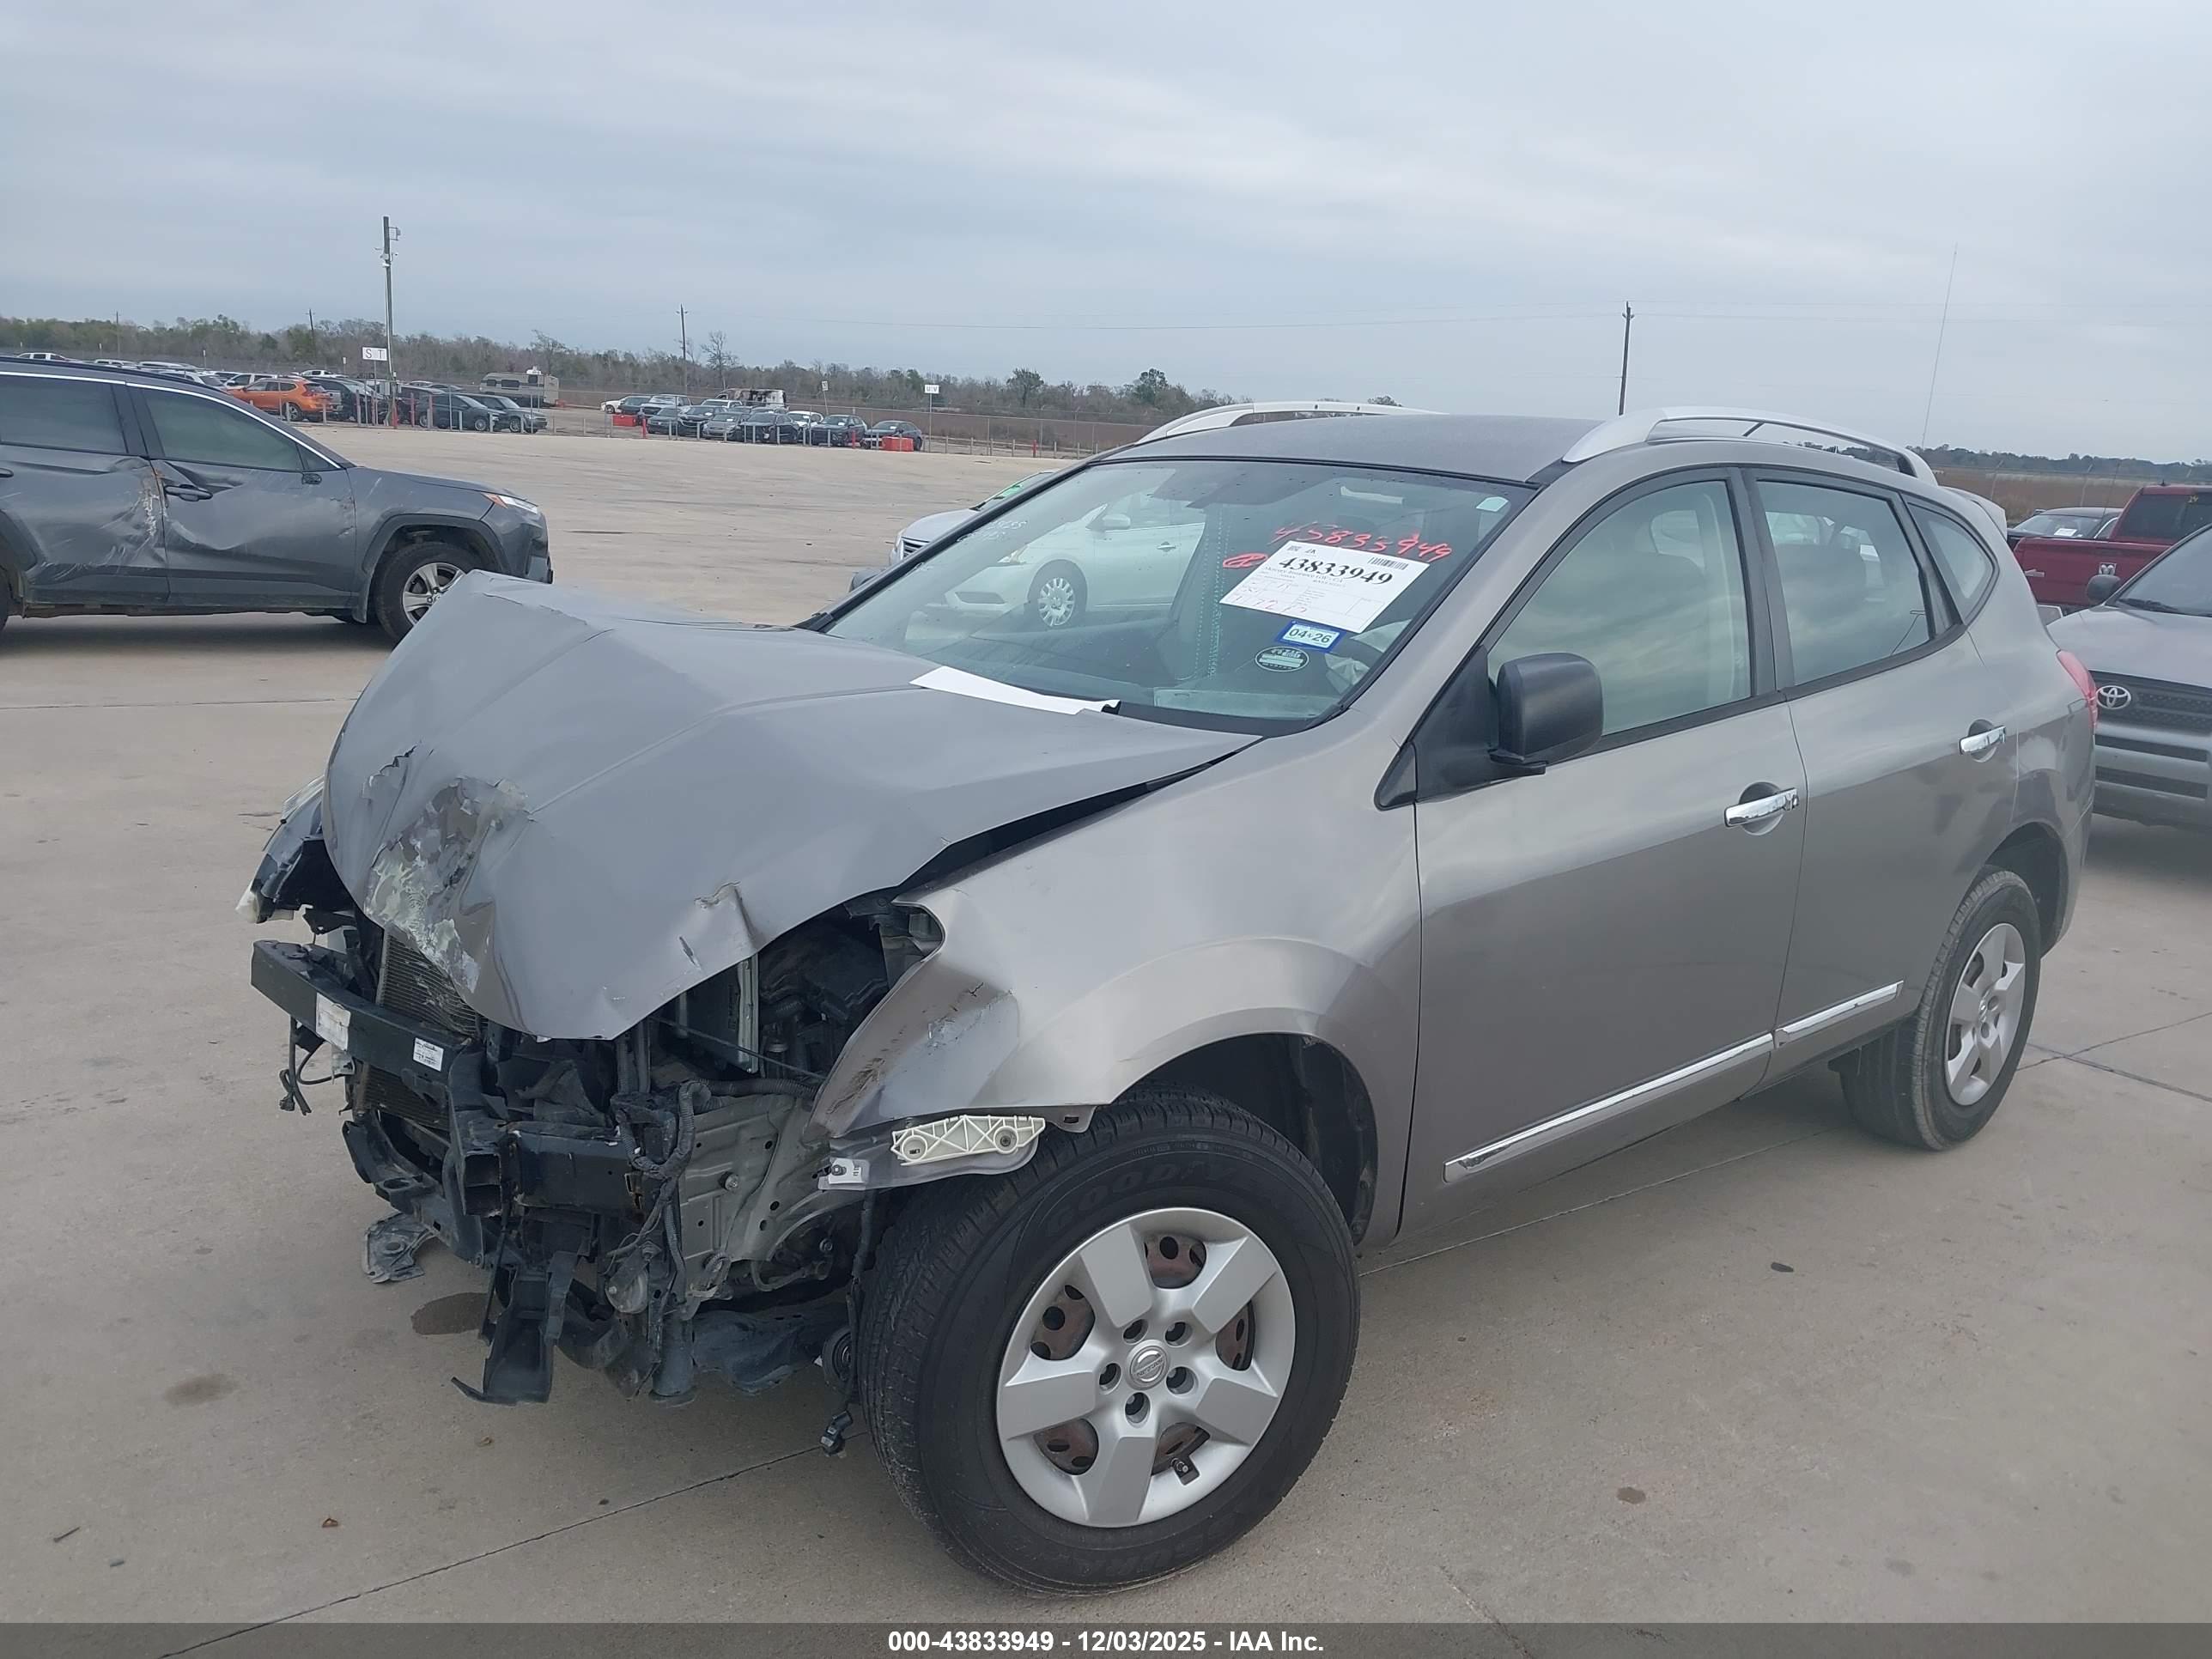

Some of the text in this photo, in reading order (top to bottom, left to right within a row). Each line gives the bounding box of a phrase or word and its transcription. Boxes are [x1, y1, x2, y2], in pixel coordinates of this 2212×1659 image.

[366, 349, 385, 359] S T
[1279, 557, 1393, 584] 43833949
[1289, 629, 1332, 643] 04 26
